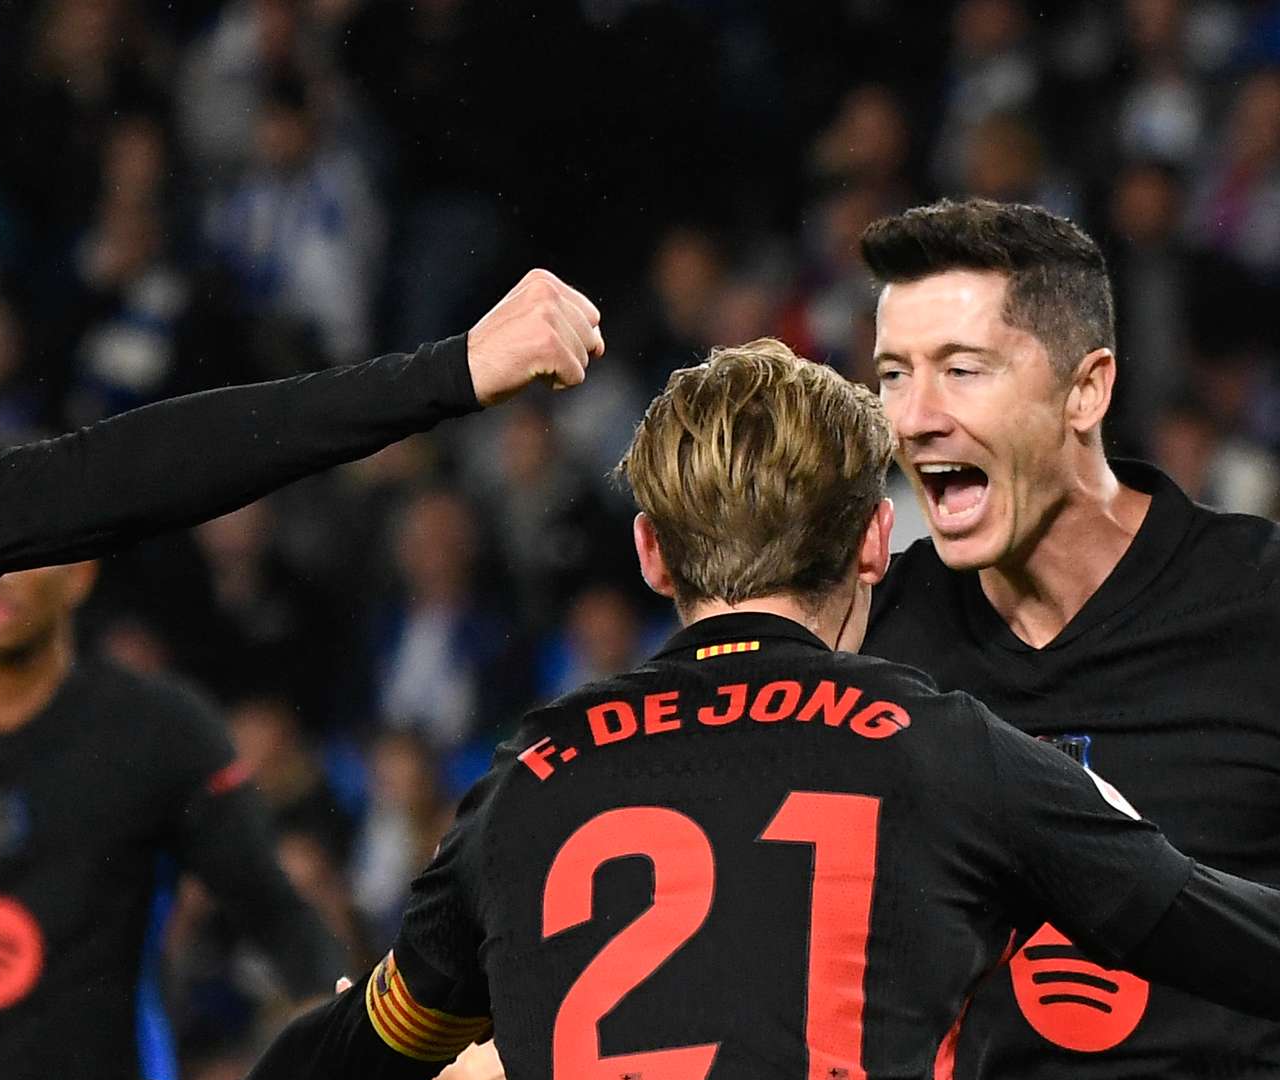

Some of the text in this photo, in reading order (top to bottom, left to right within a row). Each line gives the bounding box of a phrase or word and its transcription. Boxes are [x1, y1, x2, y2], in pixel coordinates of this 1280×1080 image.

[517, 680, 912, 782] F. DE JONG
